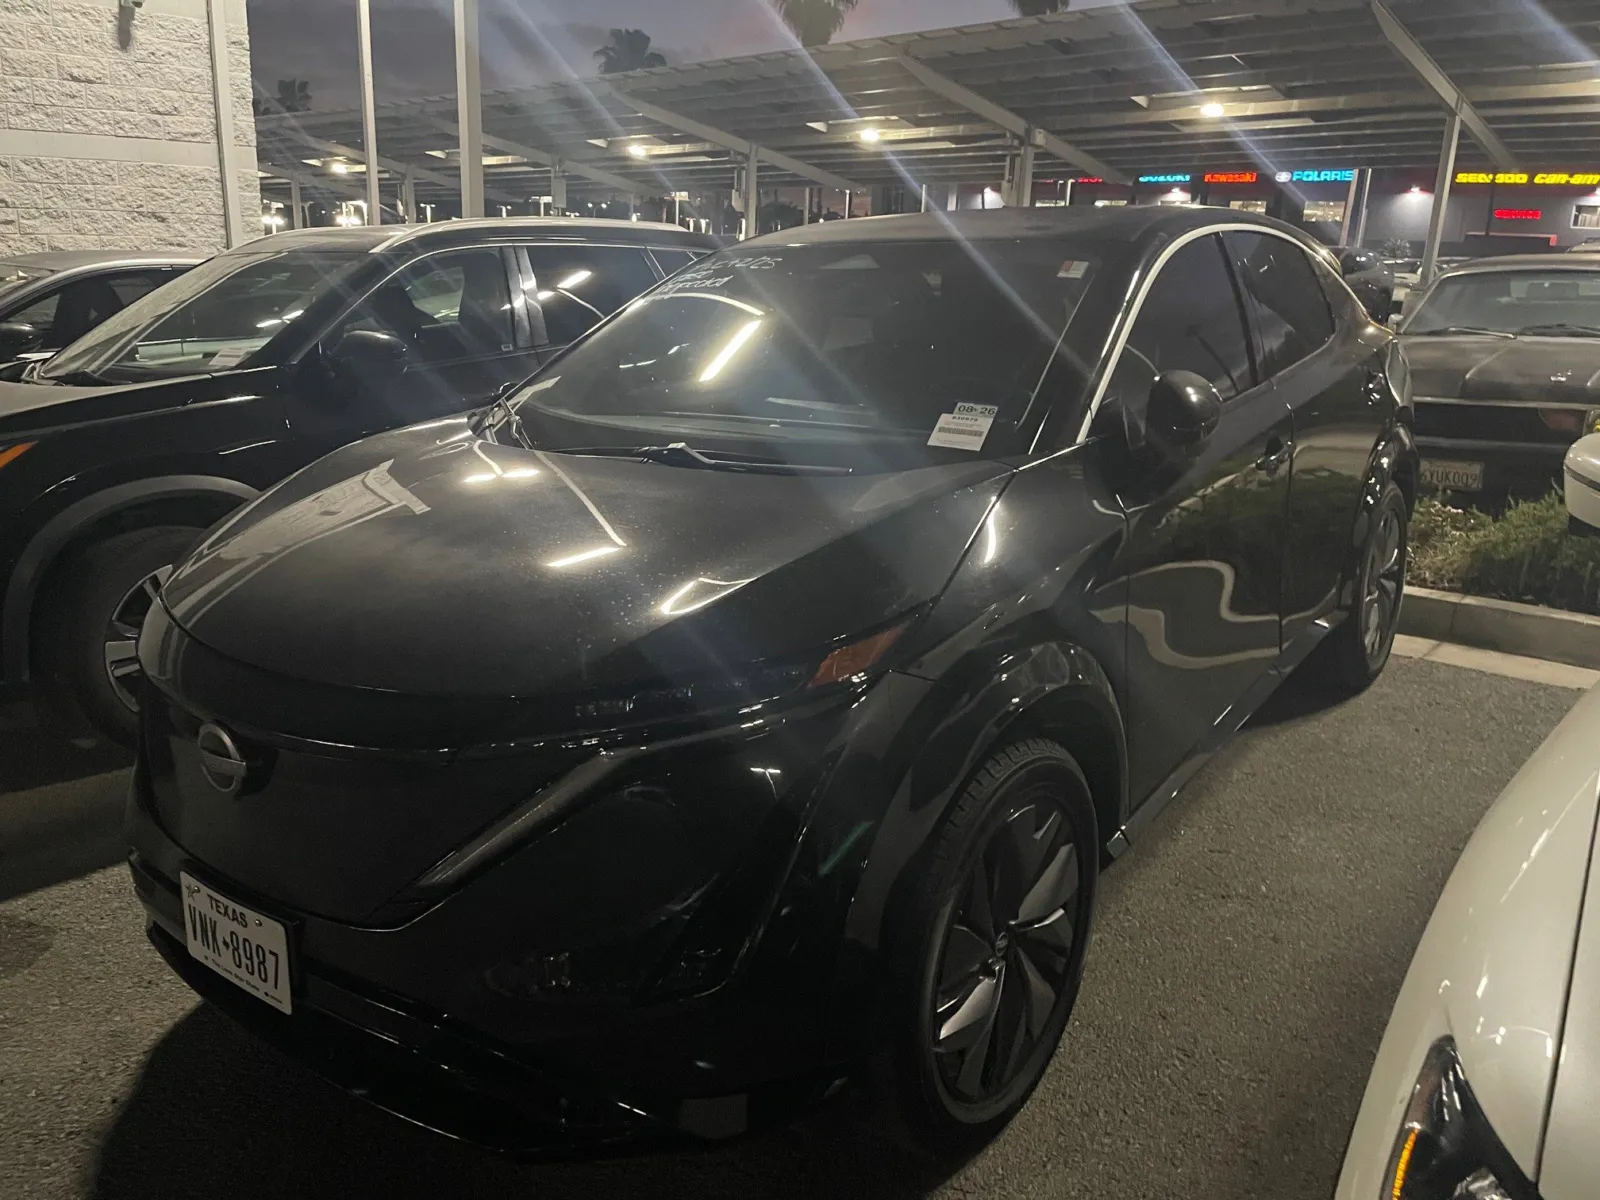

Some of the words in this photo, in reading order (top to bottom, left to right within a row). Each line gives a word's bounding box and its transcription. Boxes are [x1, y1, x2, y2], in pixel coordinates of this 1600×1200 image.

[1204, 172, 1257, 183] Kawasaki
[1292, 169, 1355, 182] POLARIS
[207, 894, 248, 928] TEXAS
